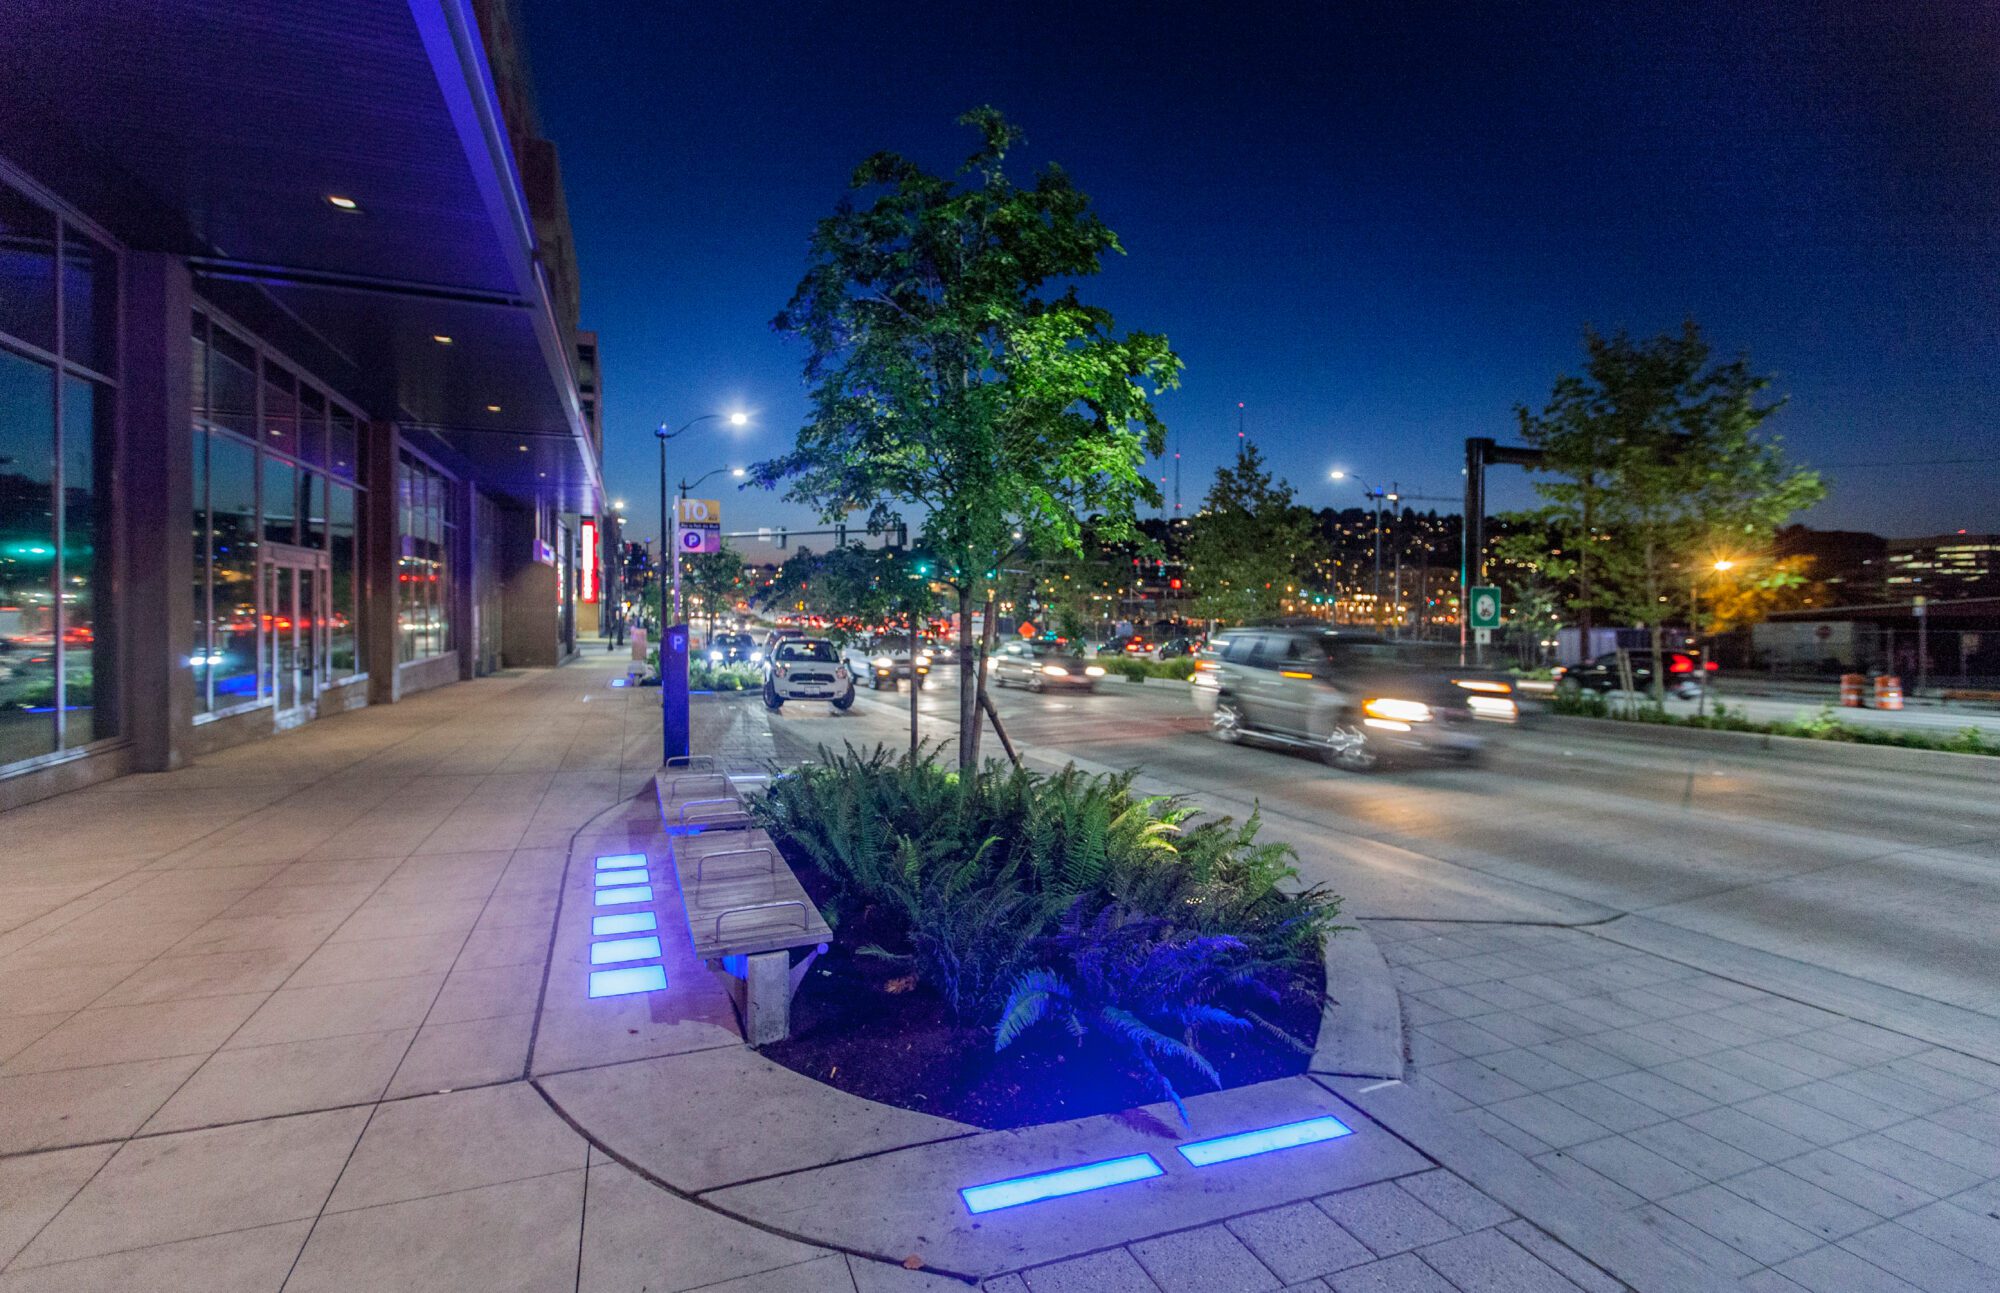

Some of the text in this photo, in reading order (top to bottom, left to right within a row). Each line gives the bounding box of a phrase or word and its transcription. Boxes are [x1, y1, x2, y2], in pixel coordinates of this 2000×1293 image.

[681, 502, 708, 522] 10
[688, 535, 698, 547] P
[673, 635, 684, 651] P
